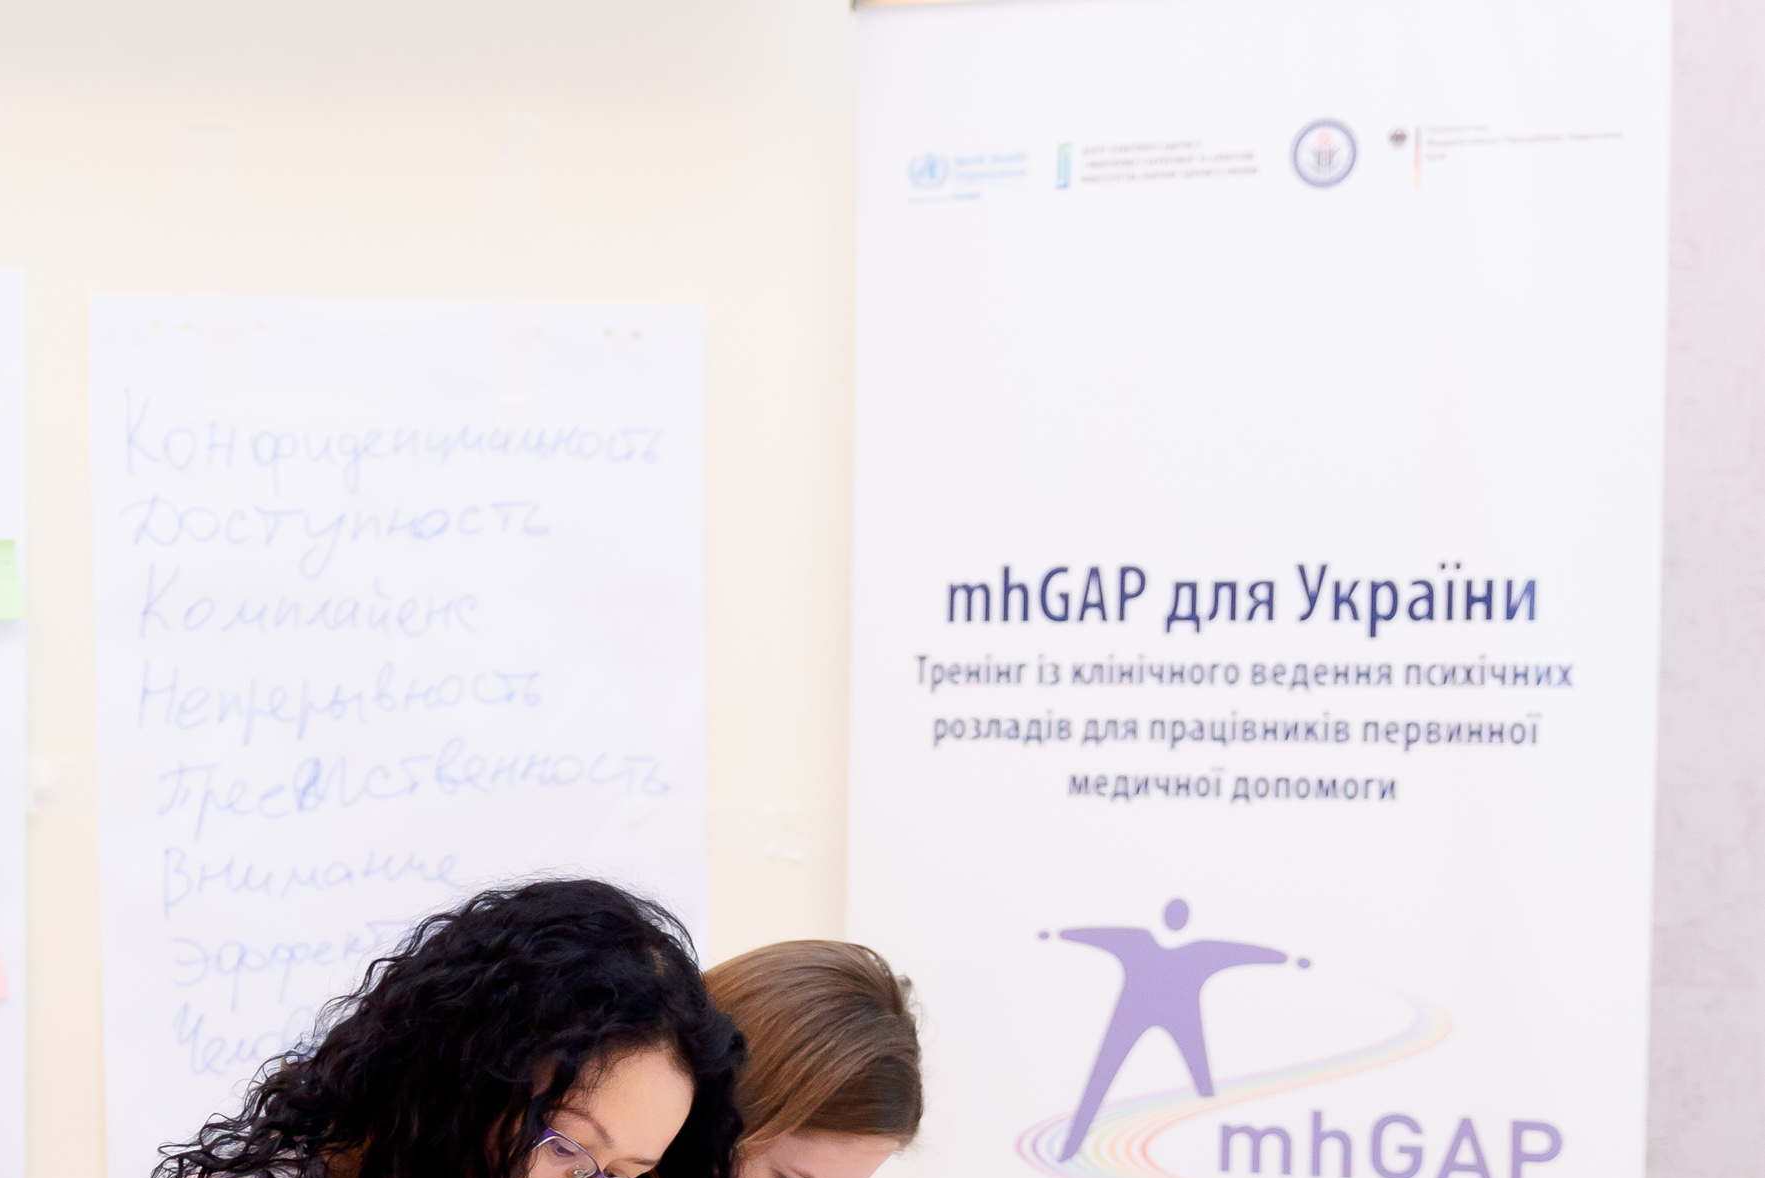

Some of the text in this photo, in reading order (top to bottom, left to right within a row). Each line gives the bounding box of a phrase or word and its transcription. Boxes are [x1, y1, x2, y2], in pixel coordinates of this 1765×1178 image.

[118, 492, 550, 580] Доступность
[947, 562, 1537, 639] mhGAP для України
[138, 660, 544, 746] Непрерывность
[915, 654, 1573, 693] Тренінг із клінічного ведення психічних
[932, 710, 1538, 753] розладів для працівників первинної
[1068, 768, 1397, 804] медичної допомоги
